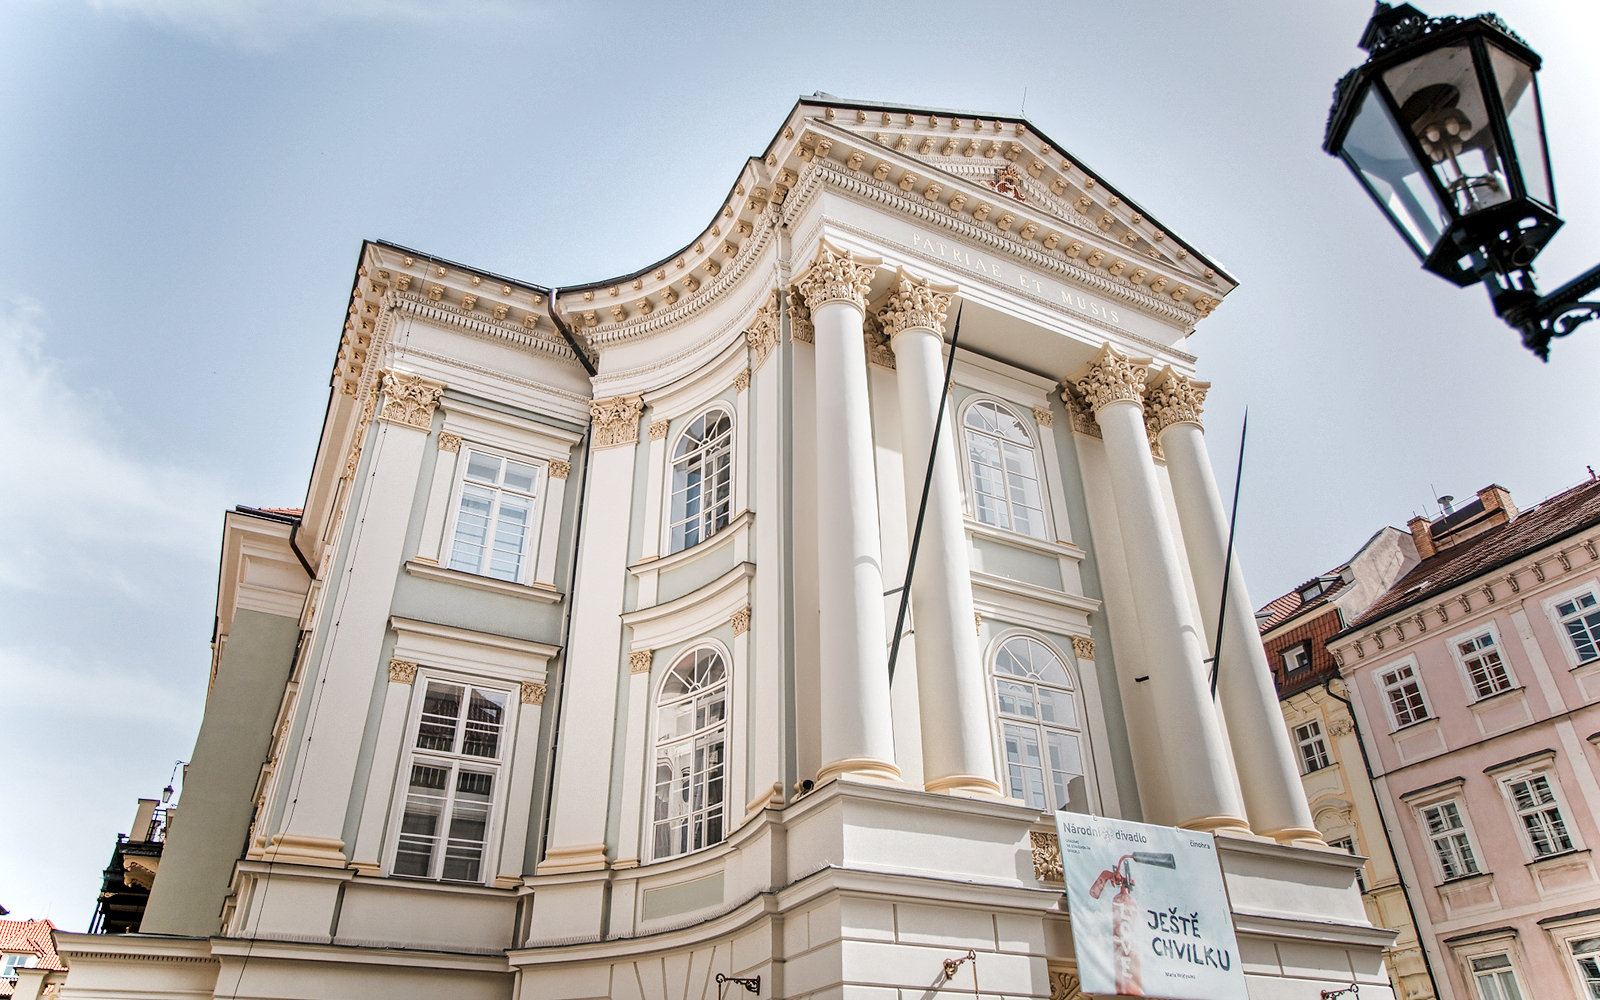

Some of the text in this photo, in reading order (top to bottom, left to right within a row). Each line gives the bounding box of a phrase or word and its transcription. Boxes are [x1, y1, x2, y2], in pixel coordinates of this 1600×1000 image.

[912, 233, 1119, 323] PATRIAE ET MUSIS
[1063, 822, 1147, 843] Národní divadlo
[1147, 907, 1201, 939] JEŠTĚ
[1152, 937, 1230, 971] CHVILKU
